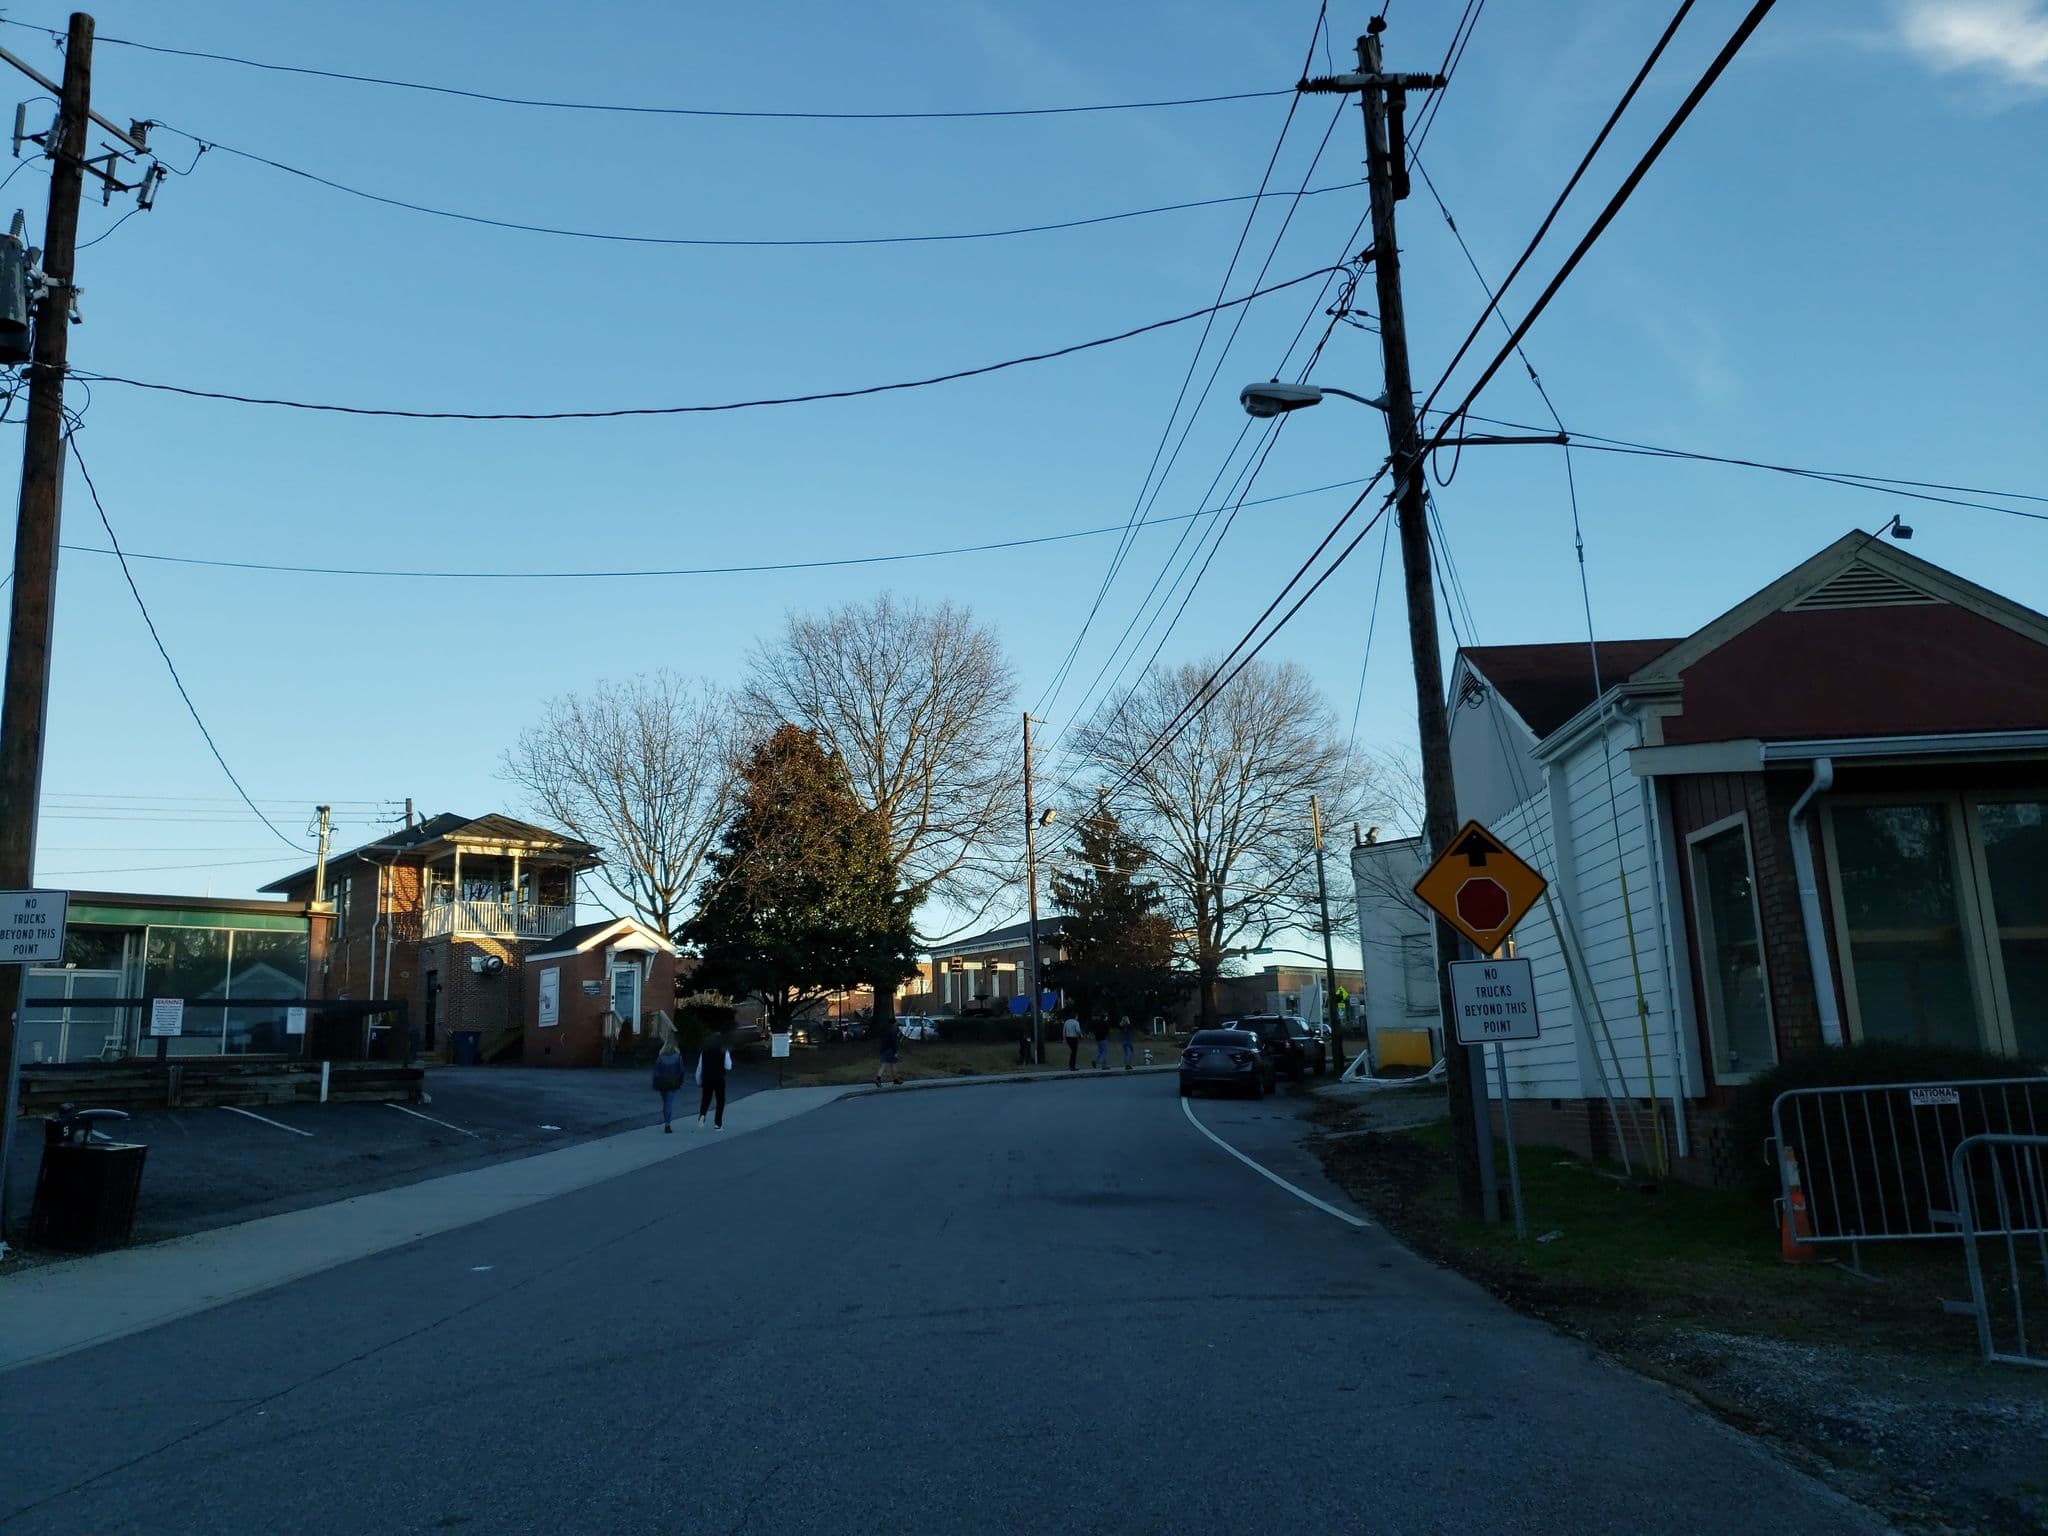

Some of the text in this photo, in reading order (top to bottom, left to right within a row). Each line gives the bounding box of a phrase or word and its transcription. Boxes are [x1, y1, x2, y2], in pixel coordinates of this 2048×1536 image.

[25, 898, 37, 909] NO
[14, 913, 46, 924] TRUCKS
[0, 928, 56, 940] BEYOND THIS
[13, 944, 39, 955] POINT
[1484, 968, 1498, 980] NO
[1475, 984, 1512, 998] TRUCKS
[1464, 1001, 1527, 1017] BEYOND THIS
[1483, 1020, 1511, 1034] POINT
[1911, 1088, 1958, 1098] NATIONAL
